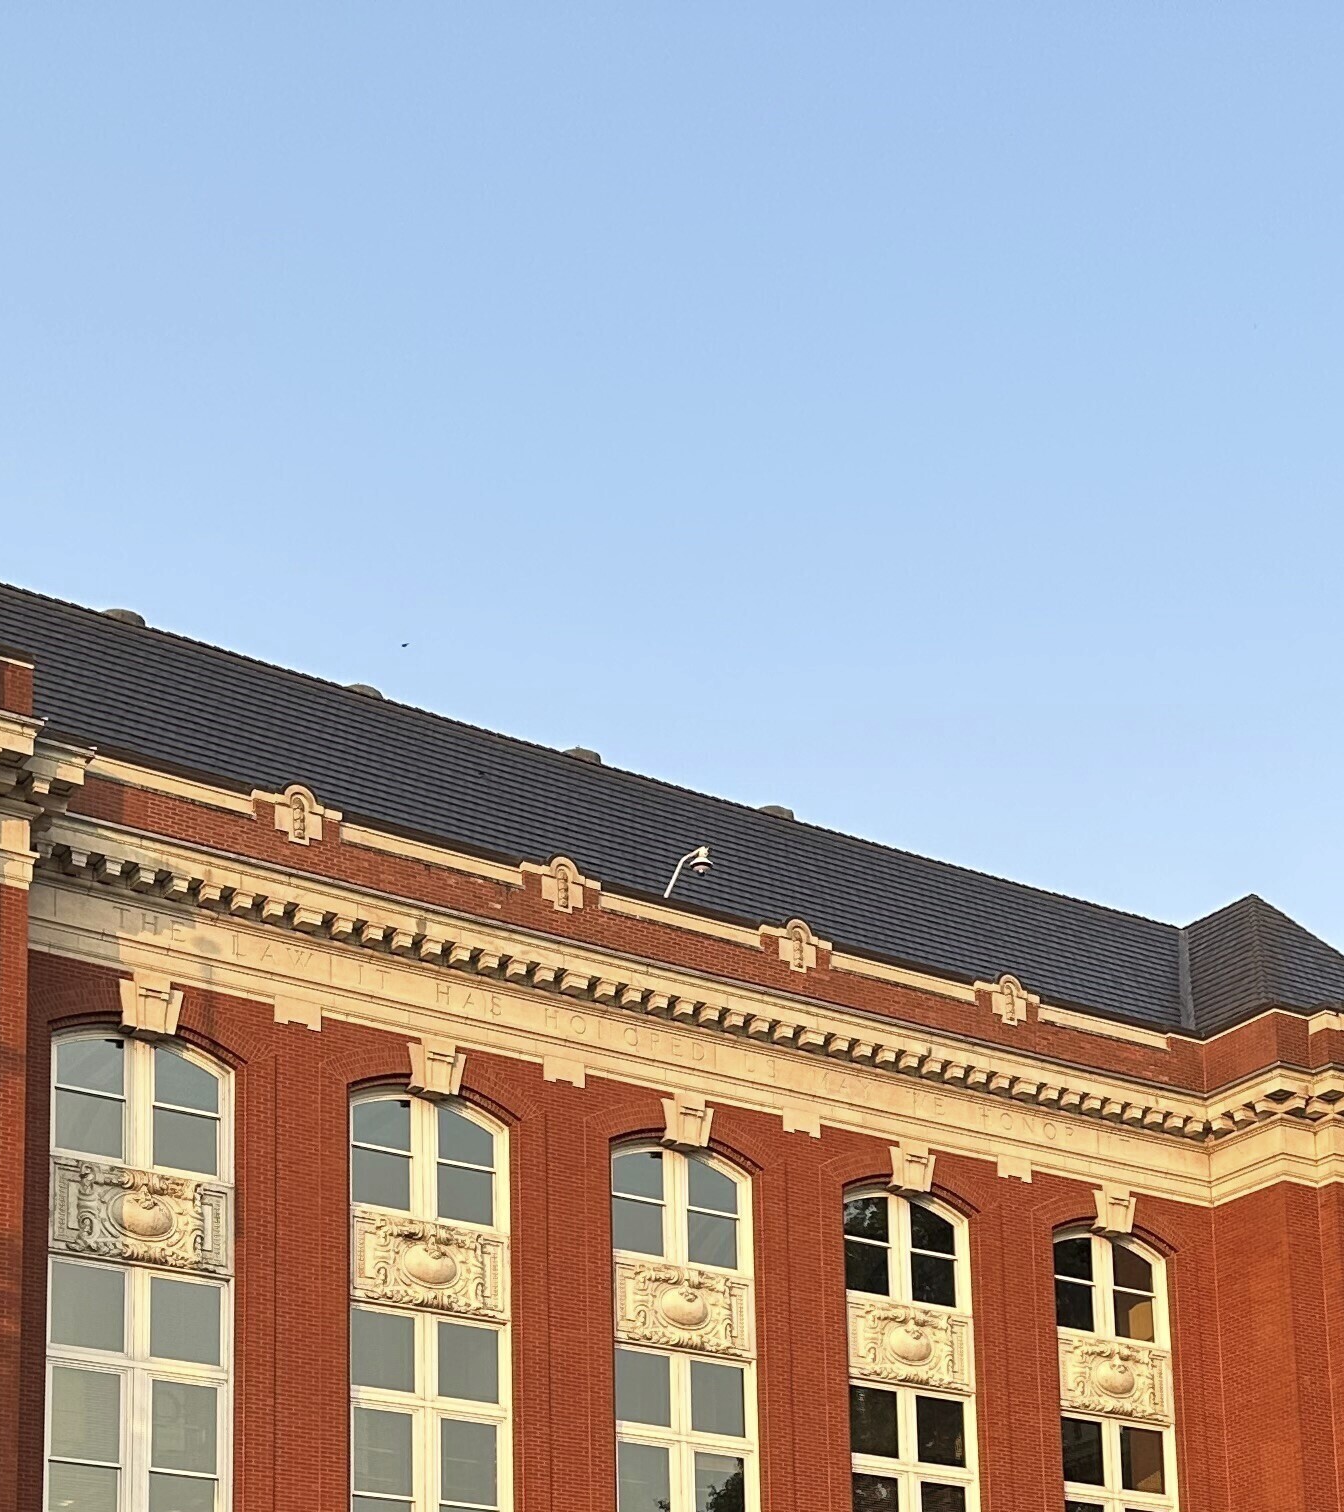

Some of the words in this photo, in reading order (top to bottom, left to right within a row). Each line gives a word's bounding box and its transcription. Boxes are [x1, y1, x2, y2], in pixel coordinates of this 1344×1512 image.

[112, 905, 188, 943] THE
[232, 934, 315, 969] LAW
[358, 963, 391, 990] IT
[435, 982, 503, 1018] HAS
[544, 1006, 706, 1063] HONORED
[743, 1053, 776, 1080] US
[977, 1104, 1077, 1144] HONOR
